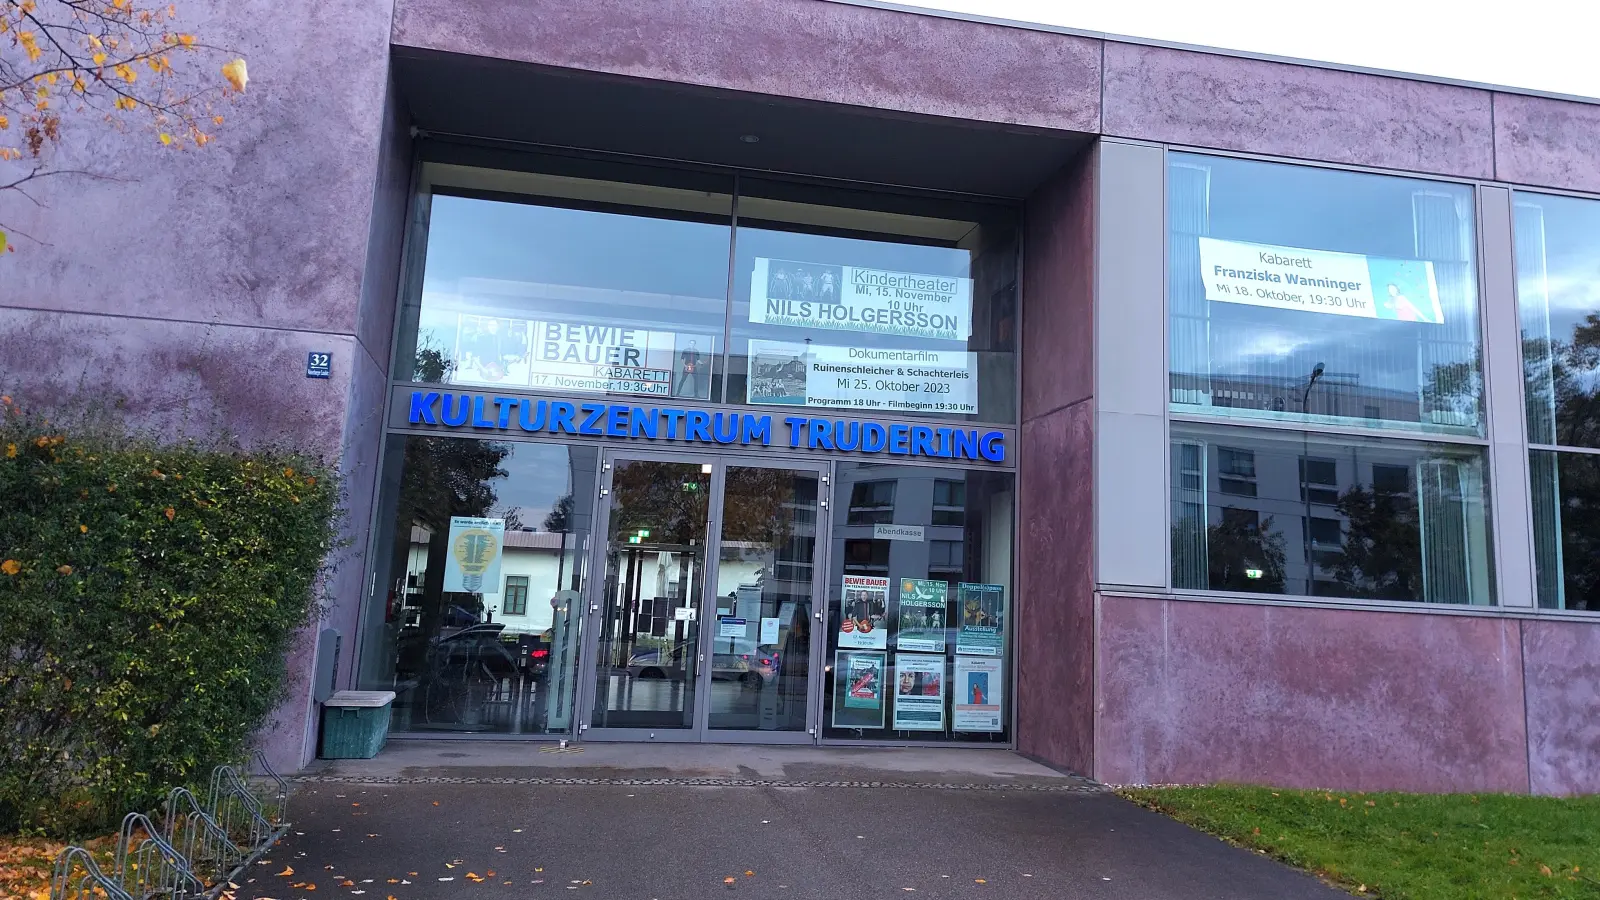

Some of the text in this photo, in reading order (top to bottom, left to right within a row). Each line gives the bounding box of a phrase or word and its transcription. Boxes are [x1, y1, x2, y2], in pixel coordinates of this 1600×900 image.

[1259, 252, 1313, 269] Kabarett
[854, 270, 955, 292] Kindertheater
[1214, 265, 1362, 293] Franziska Wanninger
[855, 285, 952, 303] Mi, 15. November
[1216, 284, 1366, 309] Mi 18. Oktober, 19:30 Uhr
[888, 300, 924, 313] 10 Uhr
[766, 299, 958, 330] NILS HOLGERSSON
[545, 323, 635, 347] BEWIE
[311, 354, 328, 366] 32
[543, 342, 640, 366] BAUER
[849, 348, 939, 362] Dokumentarfilm
[595, 366, 669, 382] KABARETT
[813, 364, 969, 379] Ruinenschleicher & Schachterleis
[534, 374, 552, 386] 17.
[837, 378, 950, 393] Mi 25. Oktober 2023
[808, 397, 852, 407] Programm
[854, 398, 864, 406] 18
[866, 399, 880, 407] Uhr
[888, 400, 933, 411] Filmbeginn
[935, 402, 958, 410] 19:30
[960, 403, 974, 411] Uhr
[408, 392, 1006, 462] KULTURZENTRUM TRUDERING
[877, 527, 922, 537] Abendkasse
[845, 577, 865, 585] BEWIE
[901, 592, 916, 600] NILS
[901, 600, 946, 609] HOLGERSSON
